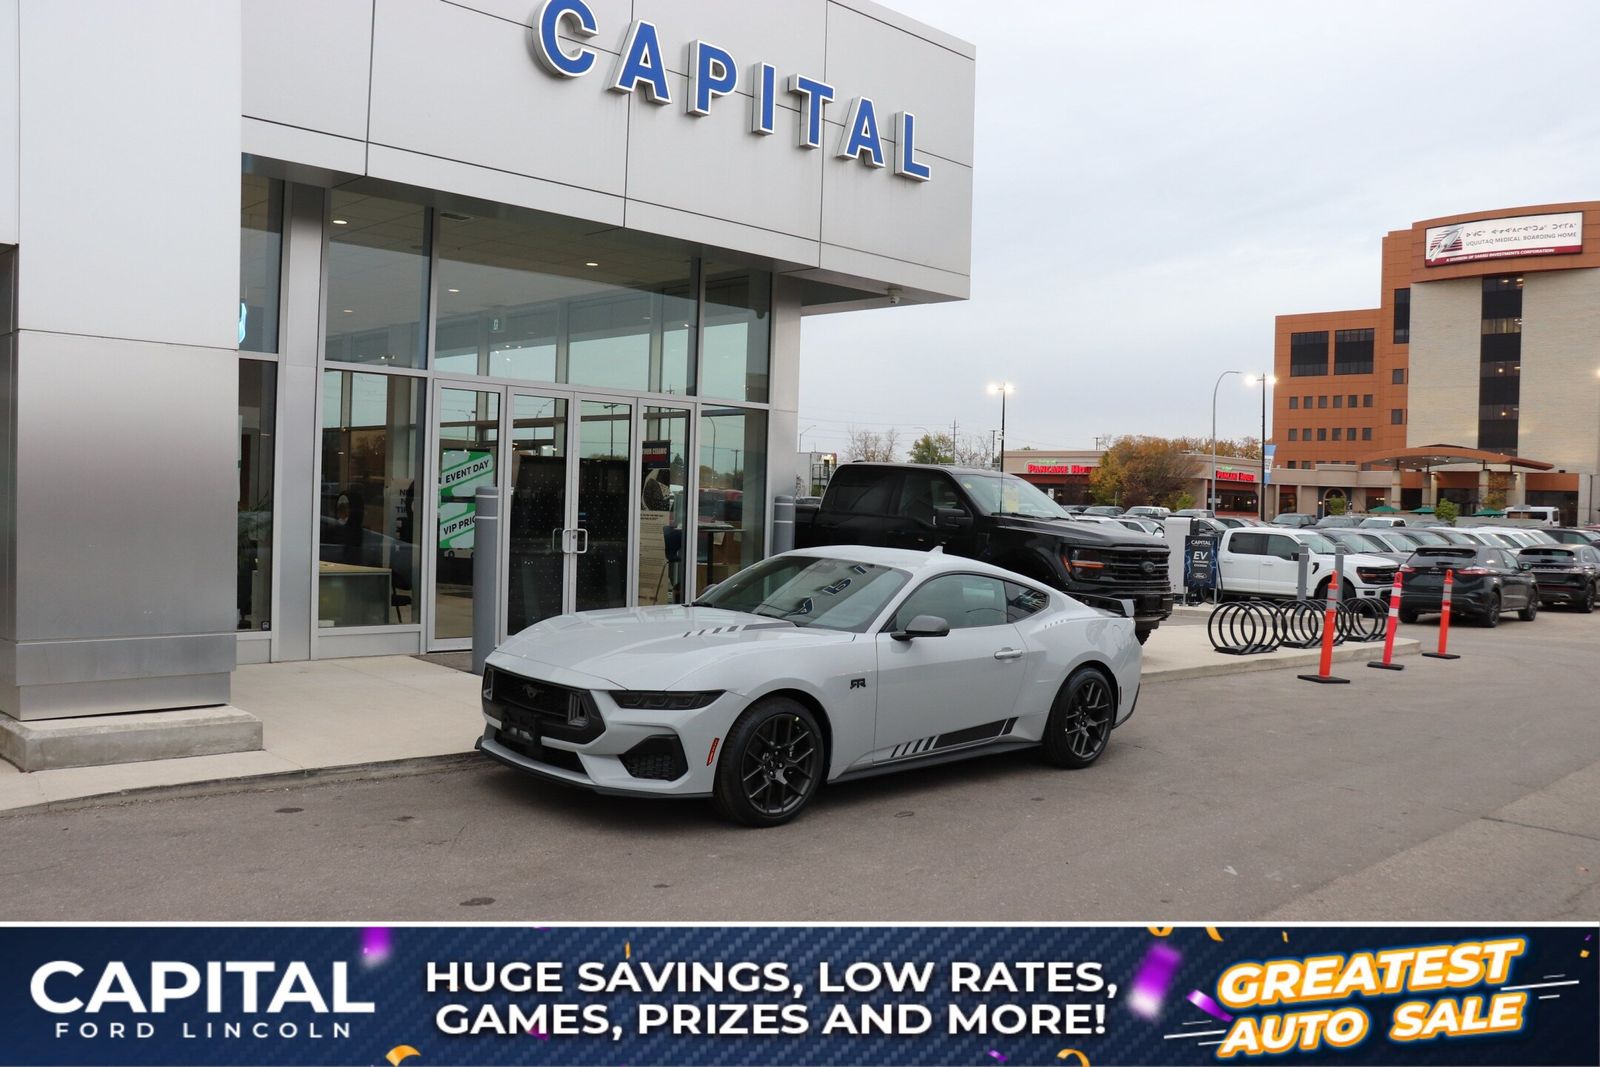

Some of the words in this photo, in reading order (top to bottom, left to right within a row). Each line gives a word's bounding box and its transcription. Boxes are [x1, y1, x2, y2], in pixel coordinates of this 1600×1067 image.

[533, 0, 930, 182] CAPITAL
[1523, 233, 1556, 241] BOARDING
[445, 466, 472, 484] EVENT
[473, 460, 489, 472] DAY
[1027, 464, 1068, 474] PANCAKE
[443, 523, 457, 535] VIP
[1193, 551, 1208, 560] EV
